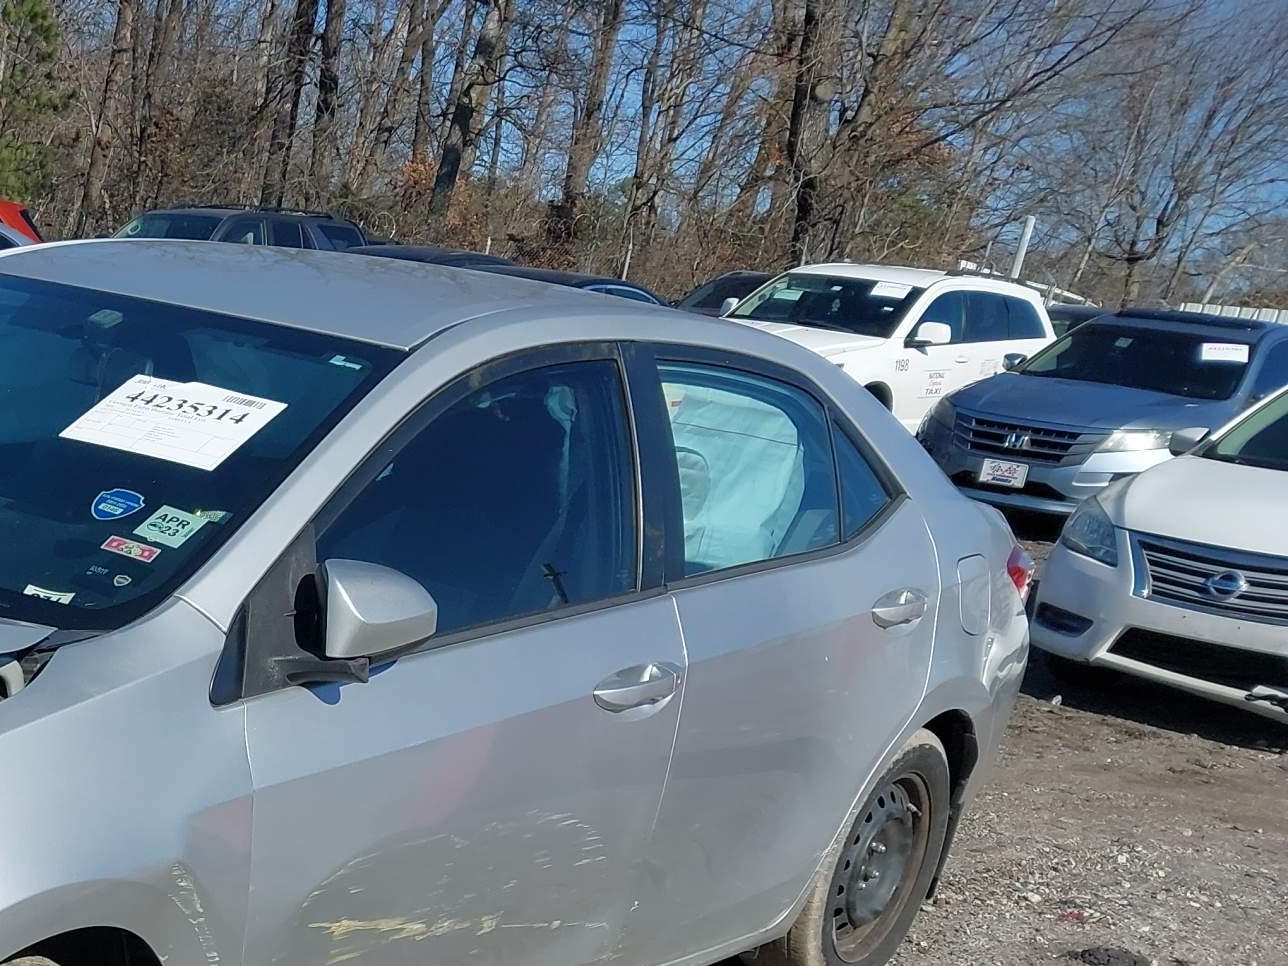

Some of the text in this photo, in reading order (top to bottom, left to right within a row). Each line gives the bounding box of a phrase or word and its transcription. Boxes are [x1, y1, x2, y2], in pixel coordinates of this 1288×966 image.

[895, 359, 910, 372] 1198
[124, 389, 251, 425] 44235314
[155, 512, 191, 530] APR
[159, 525, 180, 538] 23
